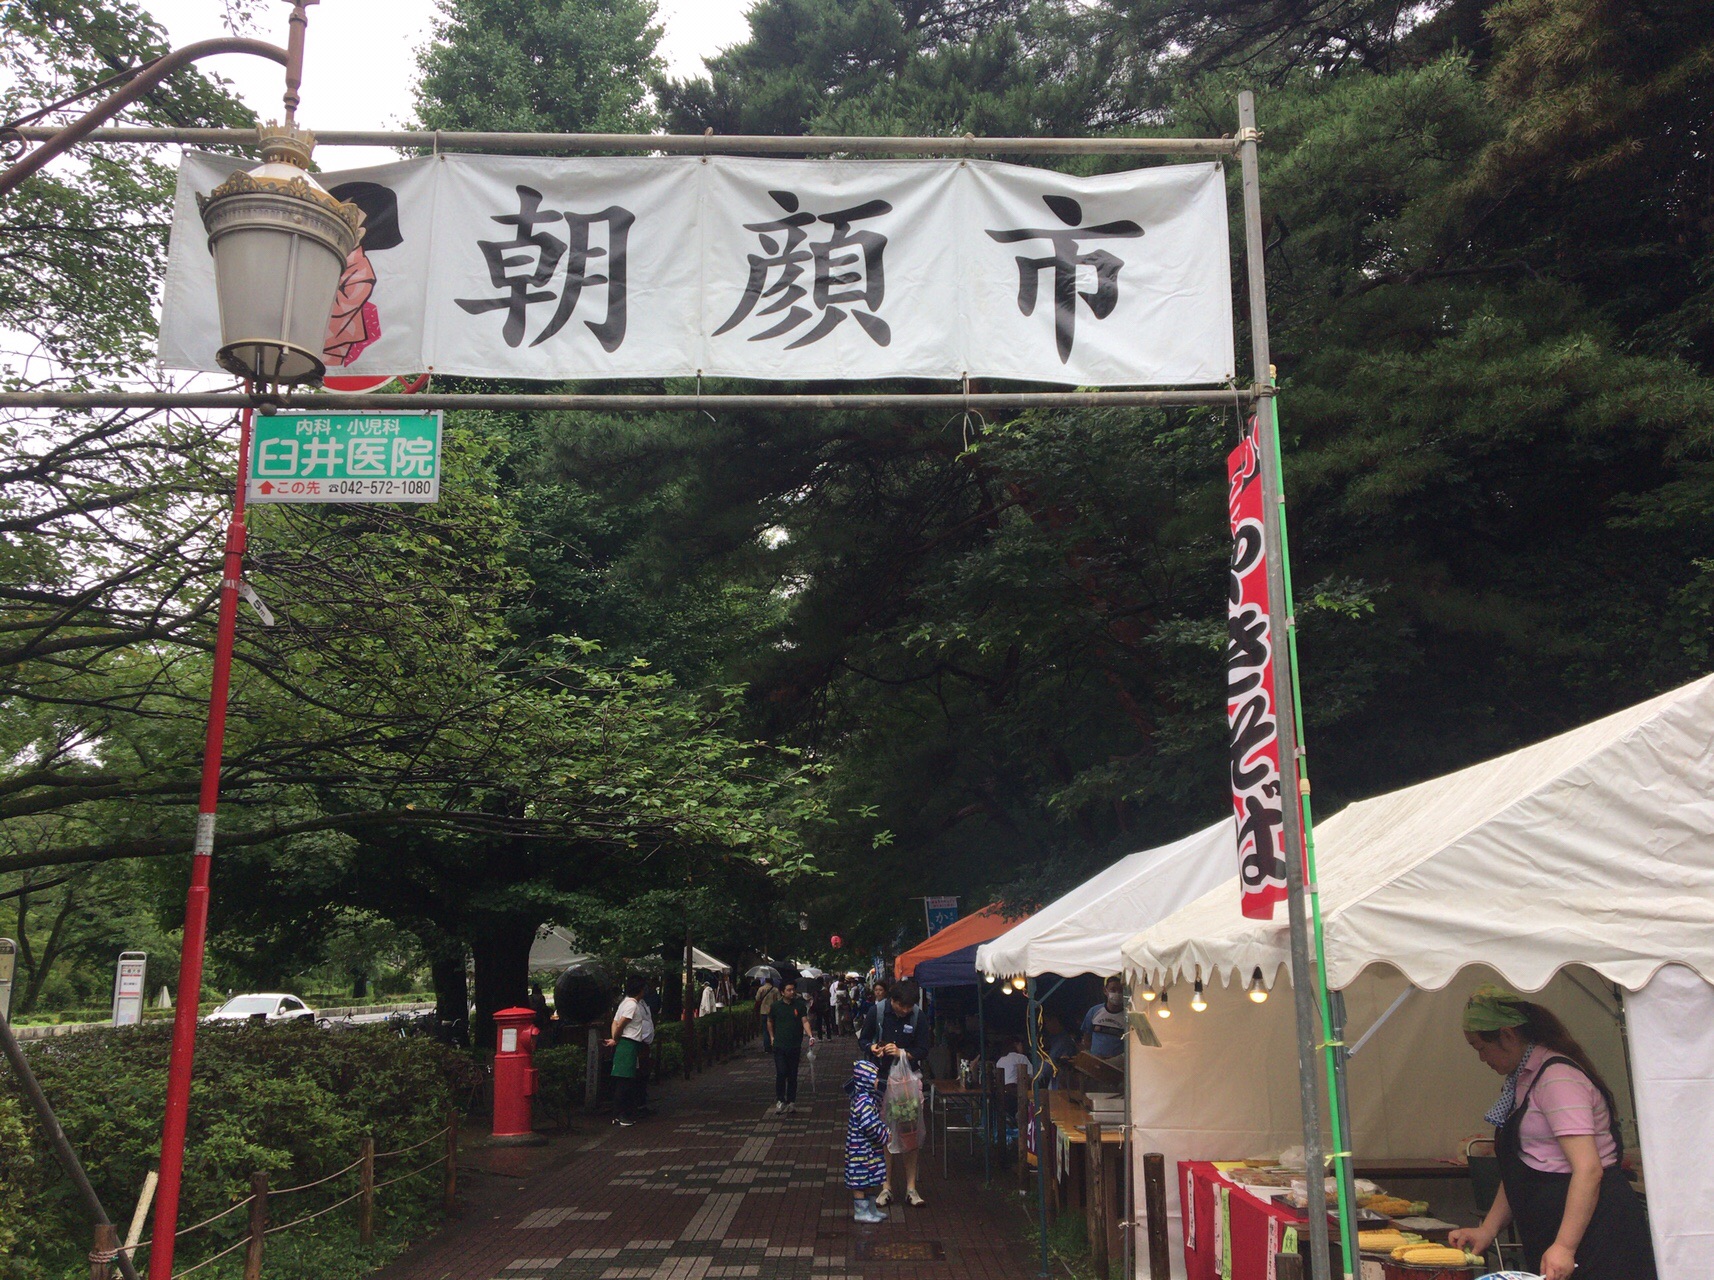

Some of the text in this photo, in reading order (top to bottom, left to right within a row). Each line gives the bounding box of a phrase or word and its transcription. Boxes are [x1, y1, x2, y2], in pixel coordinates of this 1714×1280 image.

[454, 184, 1145, 364] 朝顔市
[296, 418, 400, 436] 内科・小児科
[257, 436, 434, 477] 臼井医院
[277, 481, 321, 495] この先
[340, 480, 431, 495] 042-572-1080
[253, 599, 266, 618] 5m
